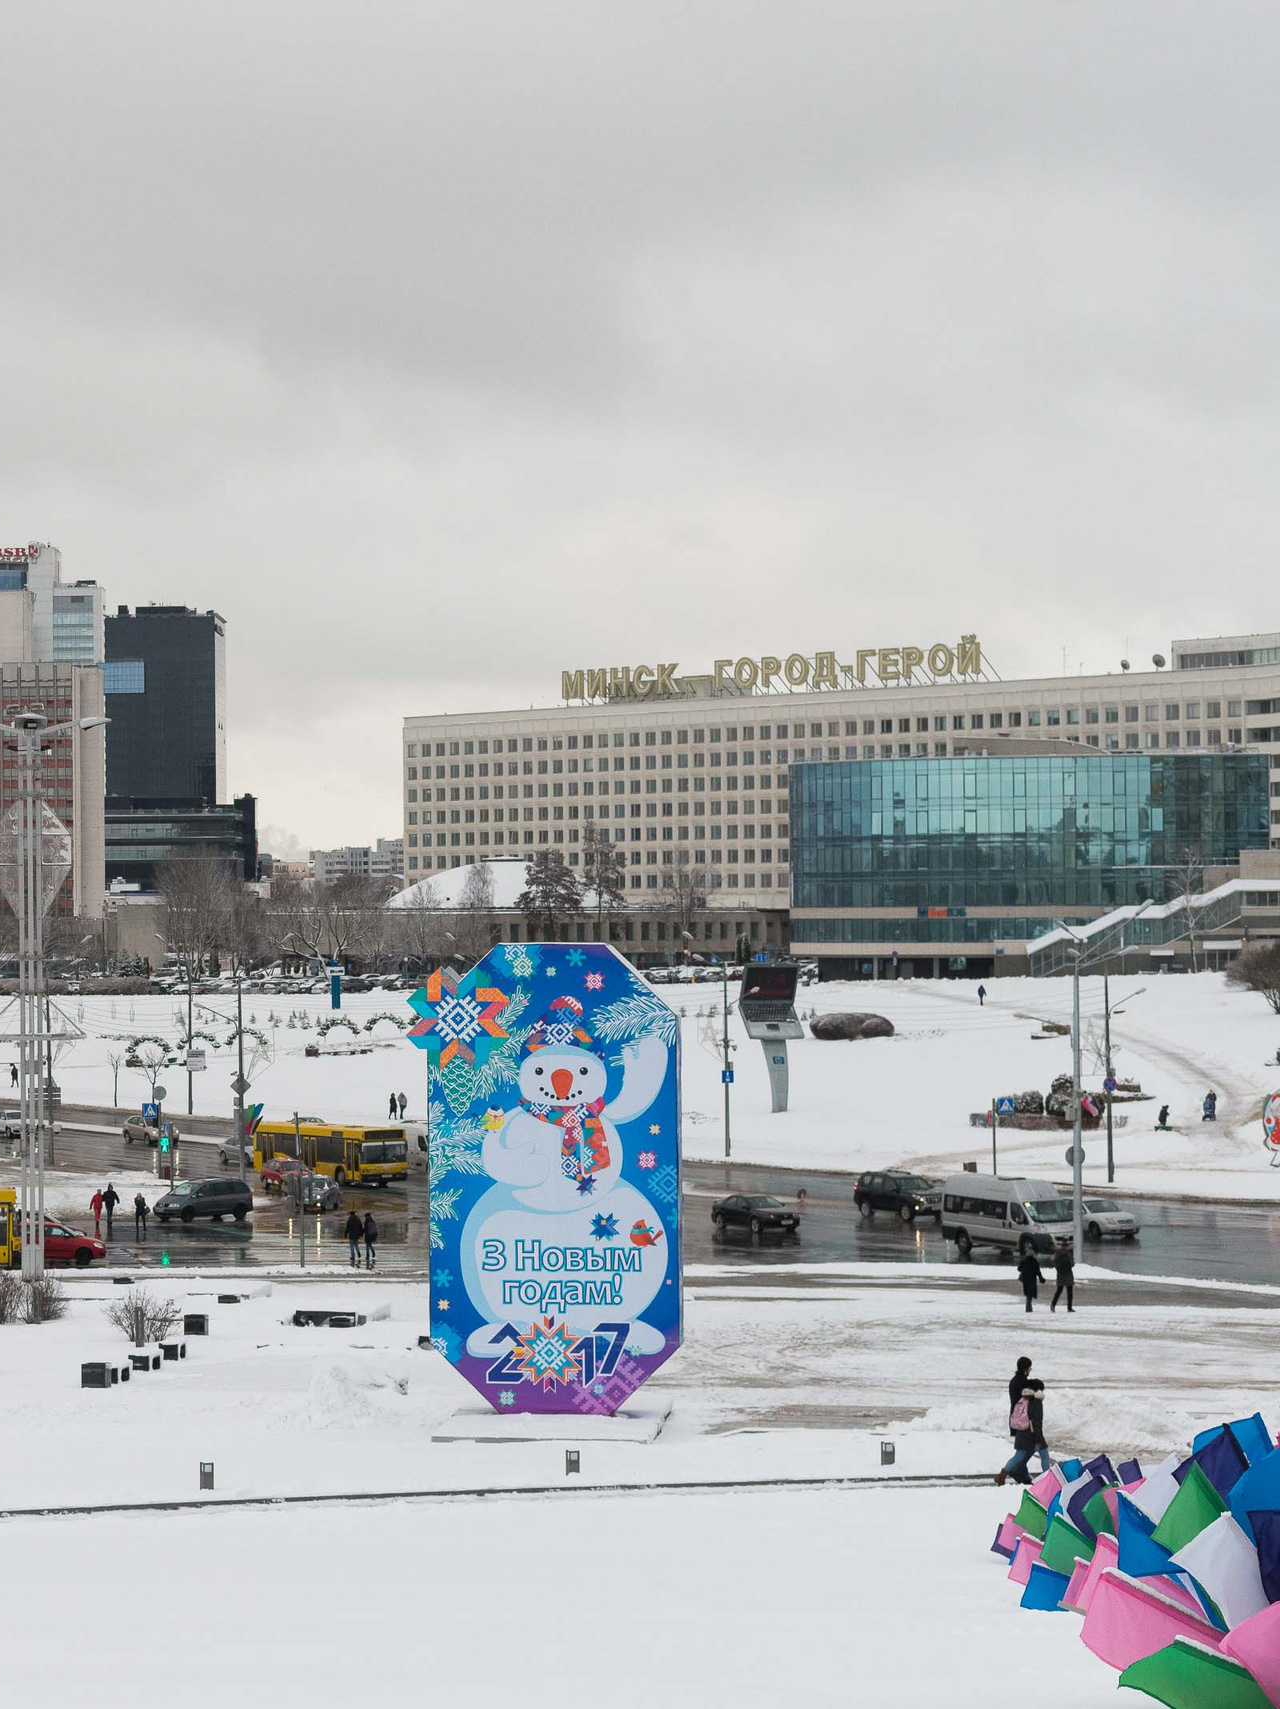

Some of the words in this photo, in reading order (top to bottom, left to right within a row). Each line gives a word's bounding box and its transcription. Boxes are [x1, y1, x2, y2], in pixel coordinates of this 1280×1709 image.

[561, 662, 680, 700] МИНСК
[514, 1239, 642, 1272] Новым
[502, 1273, 623, 1314] годам!
